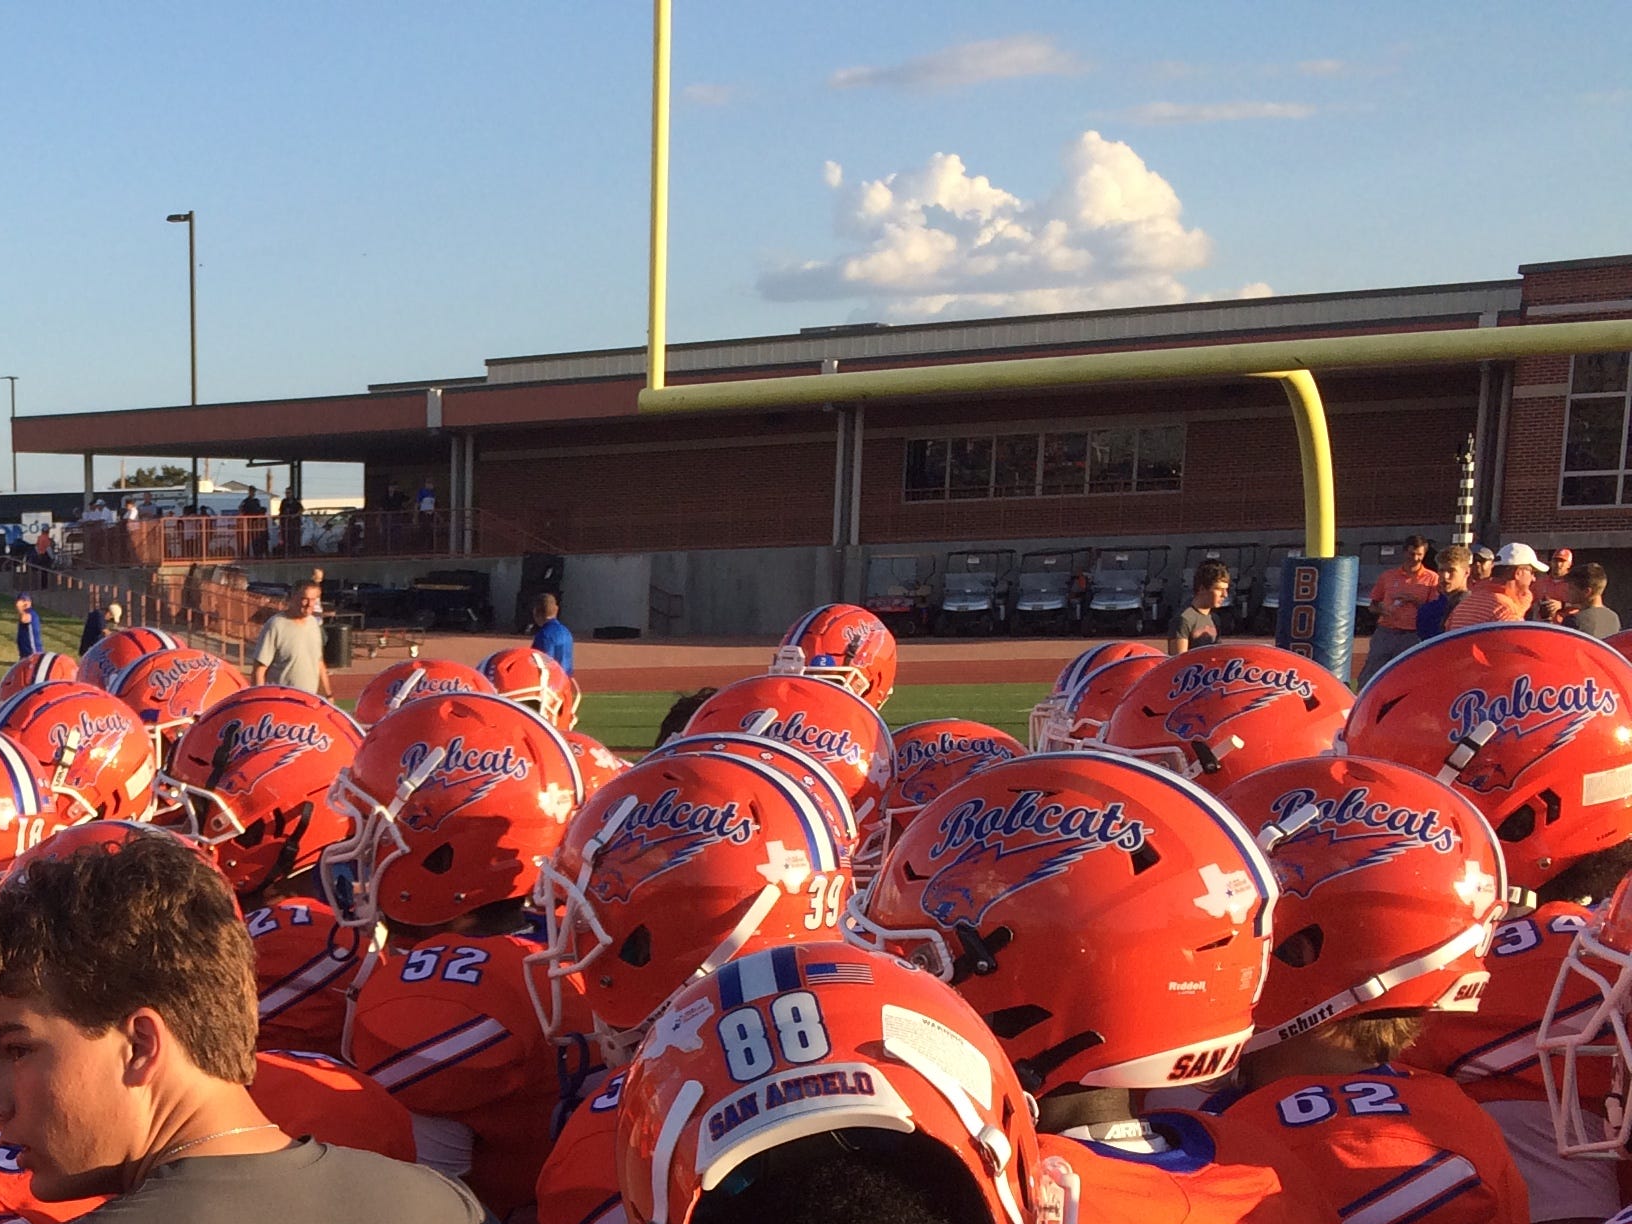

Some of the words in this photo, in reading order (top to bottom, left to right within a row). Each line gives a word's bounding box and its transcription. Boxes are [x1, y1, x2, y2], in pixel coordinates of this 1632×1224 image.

[1168, 658, 1315, 700] Bobcats
[1448, 673, 1620, 743] Bobcats
[397, 736, 533, 788] Bbcats
[896, 731, 1016, 773] Bobcats
[928, 789, 1155, 859] Bobcats
[1270, 786, 1462, 854] Bobcats
[802, 873, 846, 931] 39
[399, 945, 490, 987] 52
[1168, 980, 1207, 992] Riddell
[716, 988, 833, 1084] 88
[1278, 1003, 1336, 1041] schutt
[1167, 1046, 1228, 1082] SAN
[707, 1091, 759, 1142] SAN
[765, 1070, 876, 1110] ANGELO
[1275, 1081, 1410, 1129] 62
